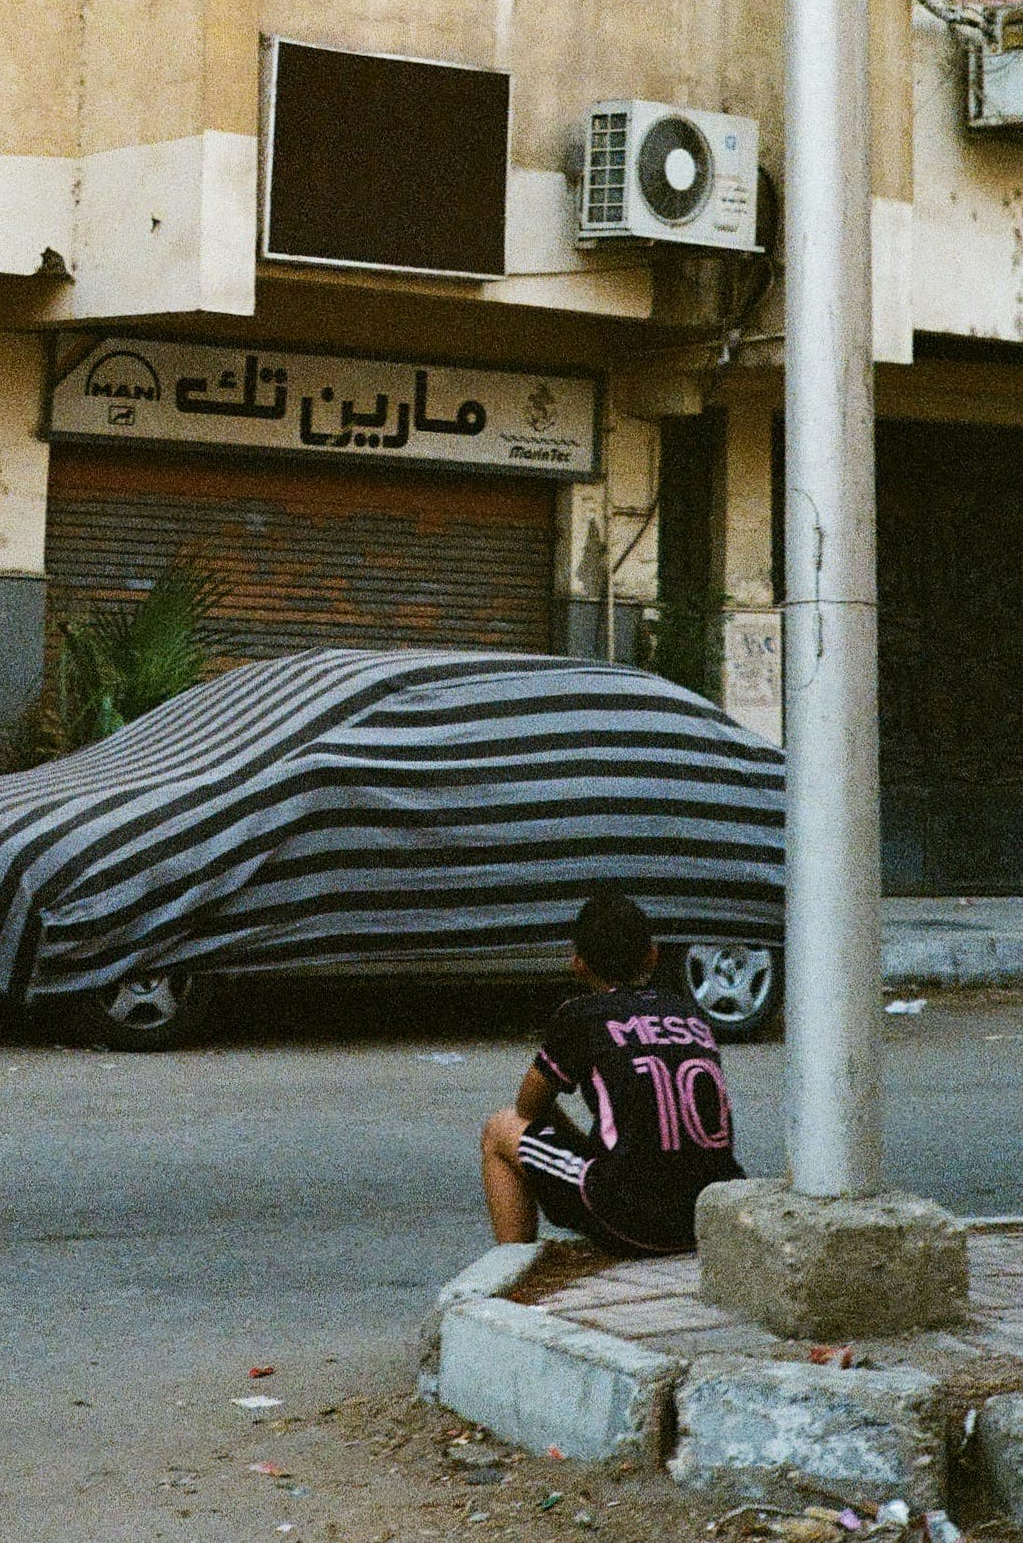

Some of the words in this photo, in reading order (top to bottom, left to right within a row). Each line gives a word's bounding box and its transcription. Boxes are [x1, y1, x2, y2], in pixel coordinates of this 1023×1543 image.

[91, 382, 155, 402] MAN
[176, 355, 288, 421] تك
[299, 369, 488, 449] مارين
[605, 1014, 720, 1054] MESS
[631, 1054, 731, 1152] 10
